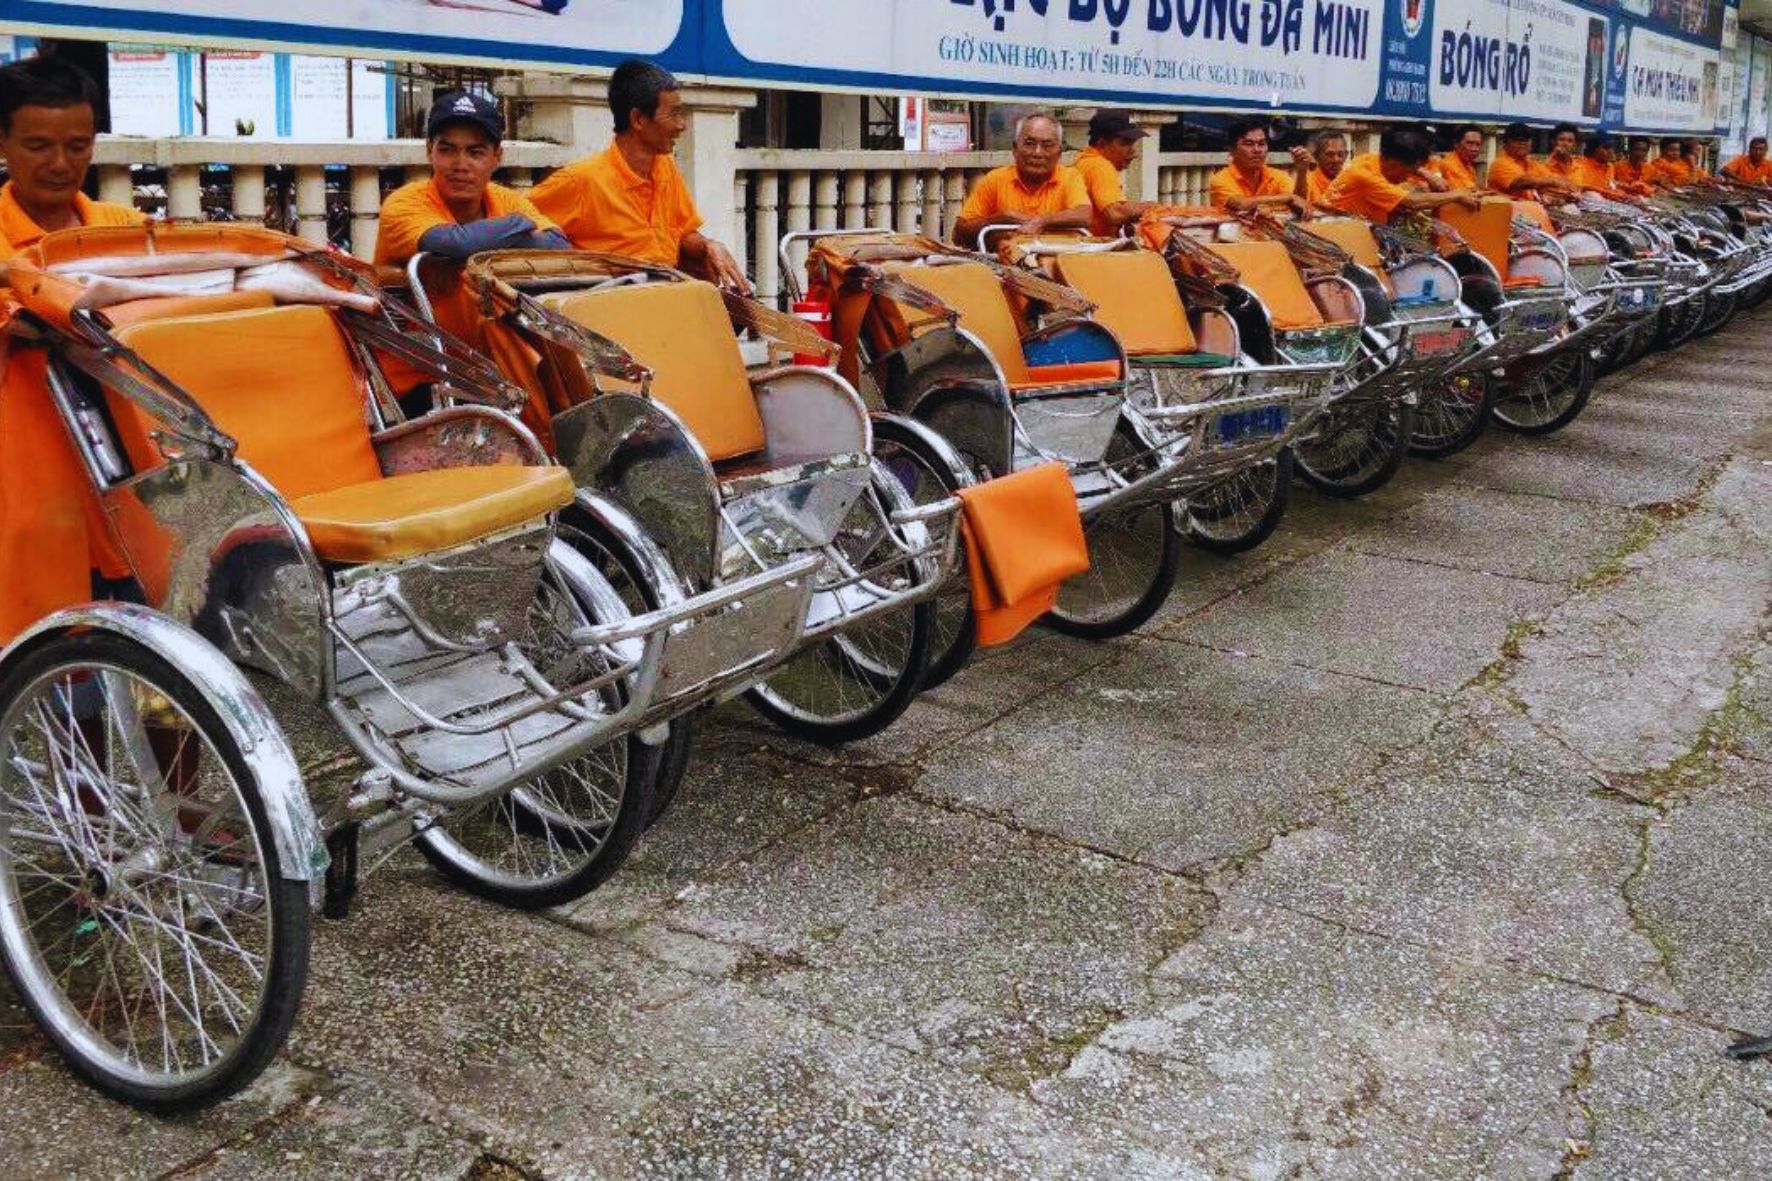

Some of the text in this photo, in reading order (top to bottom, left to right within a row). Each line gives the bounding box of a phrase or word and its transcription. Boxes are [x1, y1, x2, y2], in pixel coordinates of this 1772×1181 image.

[939, 32, 975, 62] GIỜ
[978, 41, 1019, 67] SINH
[1313, 0, 1369, 60] MINI
[1440, 20, 1500, 90] BÓNG
[1504, 22, 1533, 99] RỔ
